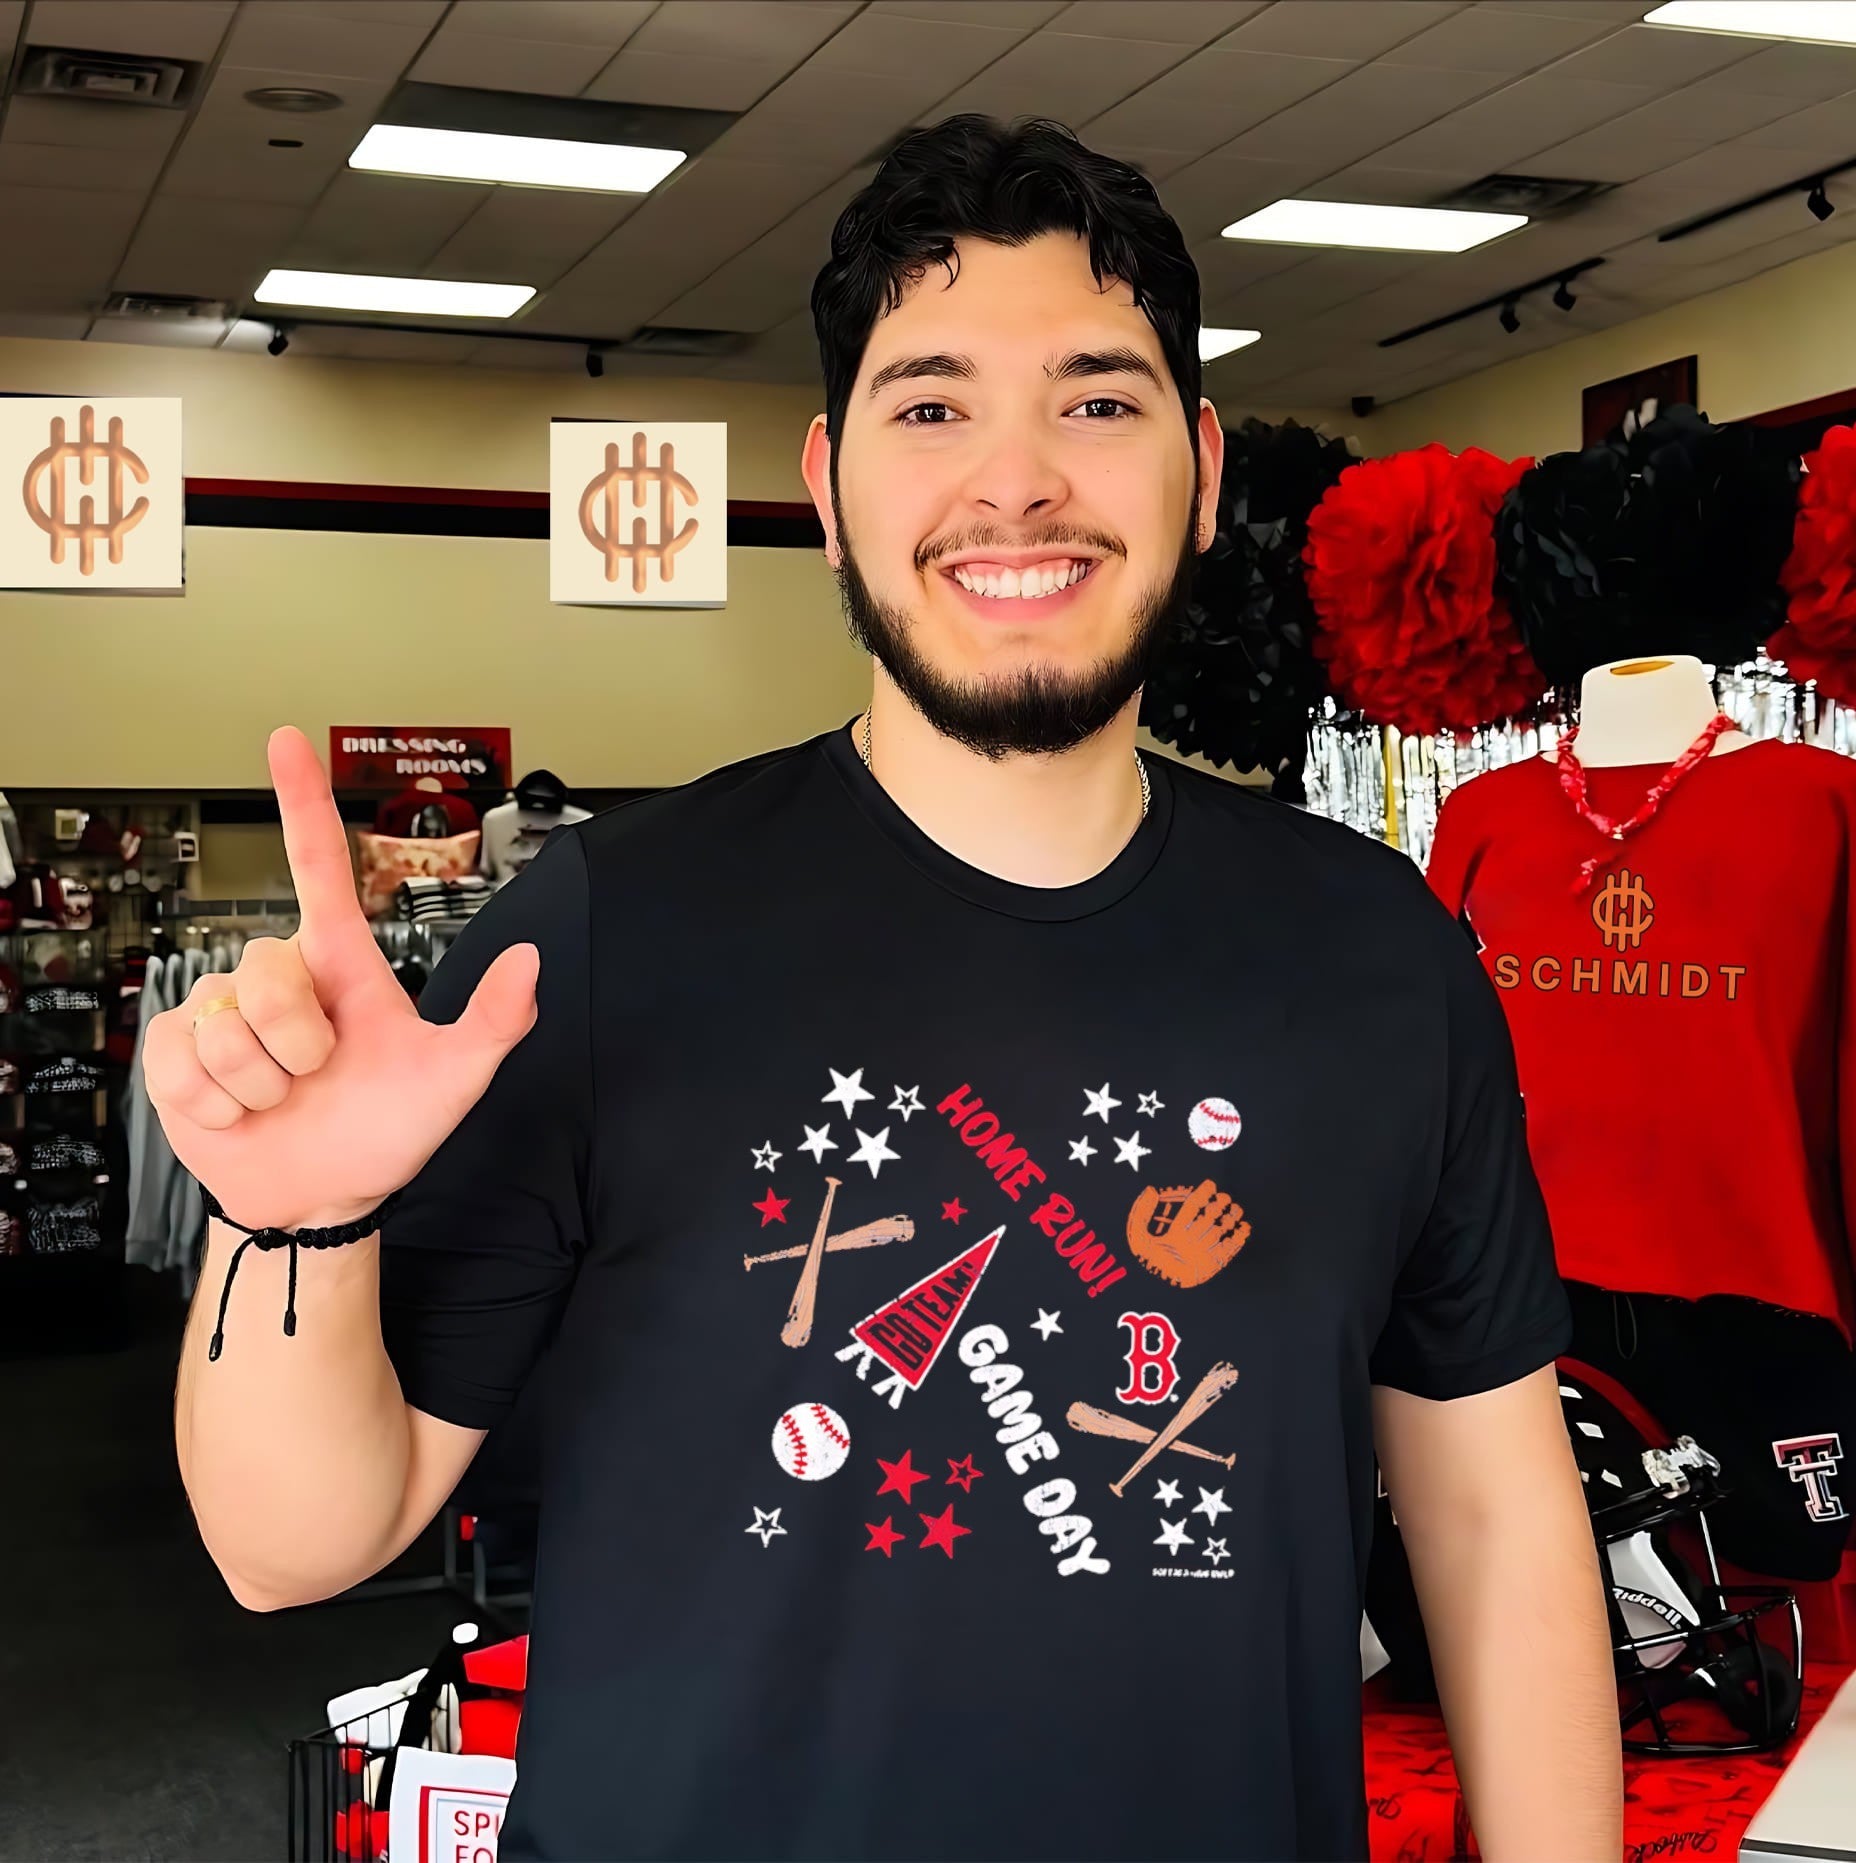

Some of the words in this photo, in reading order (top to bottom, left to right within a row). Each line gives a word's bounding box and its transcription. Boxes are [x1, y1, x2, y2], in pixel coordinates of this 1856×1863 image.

[341, 737, 467, 754] DRESSING
[396, 758, 487, 775] ROOMS
[1494, 954, 1747, 1001] SCHMIDT
[936, 1082, 1047, 1202] HOME
[1029, 1192, 1128, 1299] RUN!
[866, 1312, 934, 1371] GO
[958, 1323, 1060, 1476] GAME
[1023, 1477, 1112, 1577] DAY
